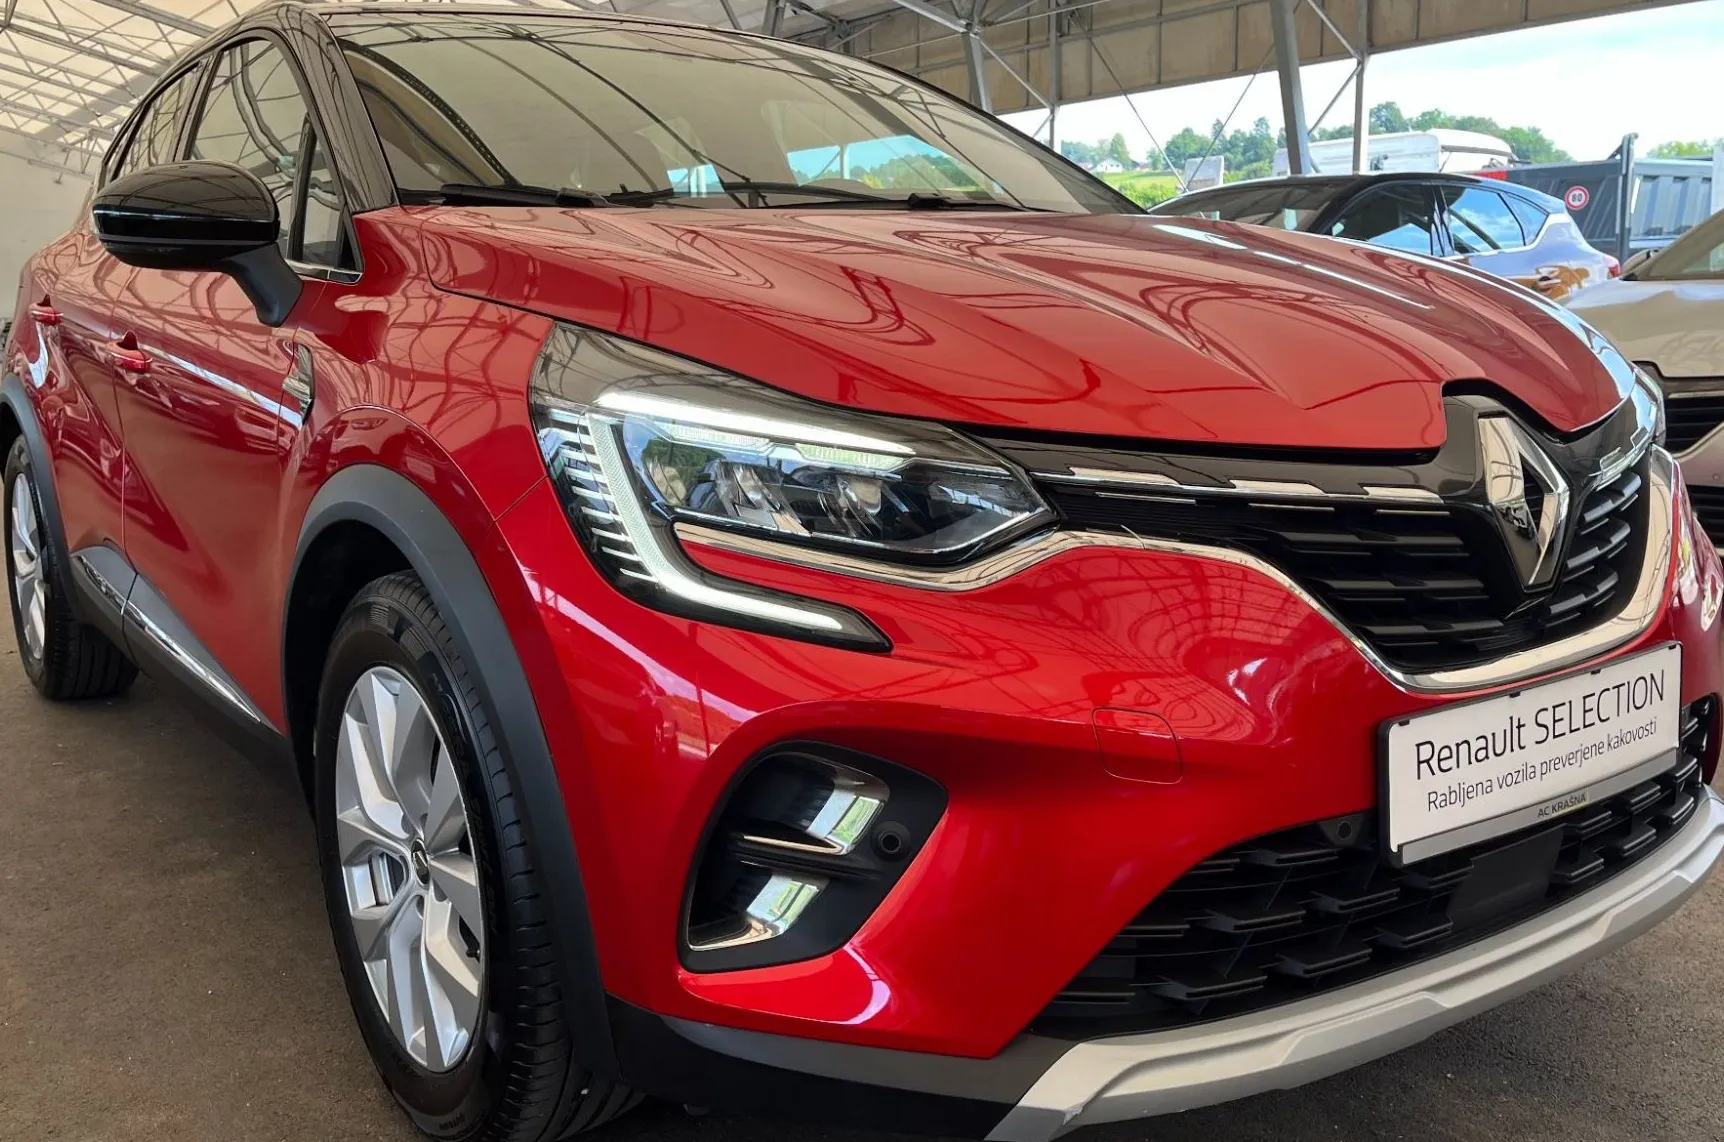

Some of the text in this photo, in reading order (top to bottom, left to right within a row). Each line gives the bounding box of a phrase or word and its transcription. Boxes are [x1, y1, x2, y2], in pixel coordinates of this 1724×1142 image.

[1415, 669, 1665, 780] Renault SELECTION
[1427, 716, 1658, 812] Rabljena vozila preverjene kakovosti
[1538, 806, 1550, 818] AC
